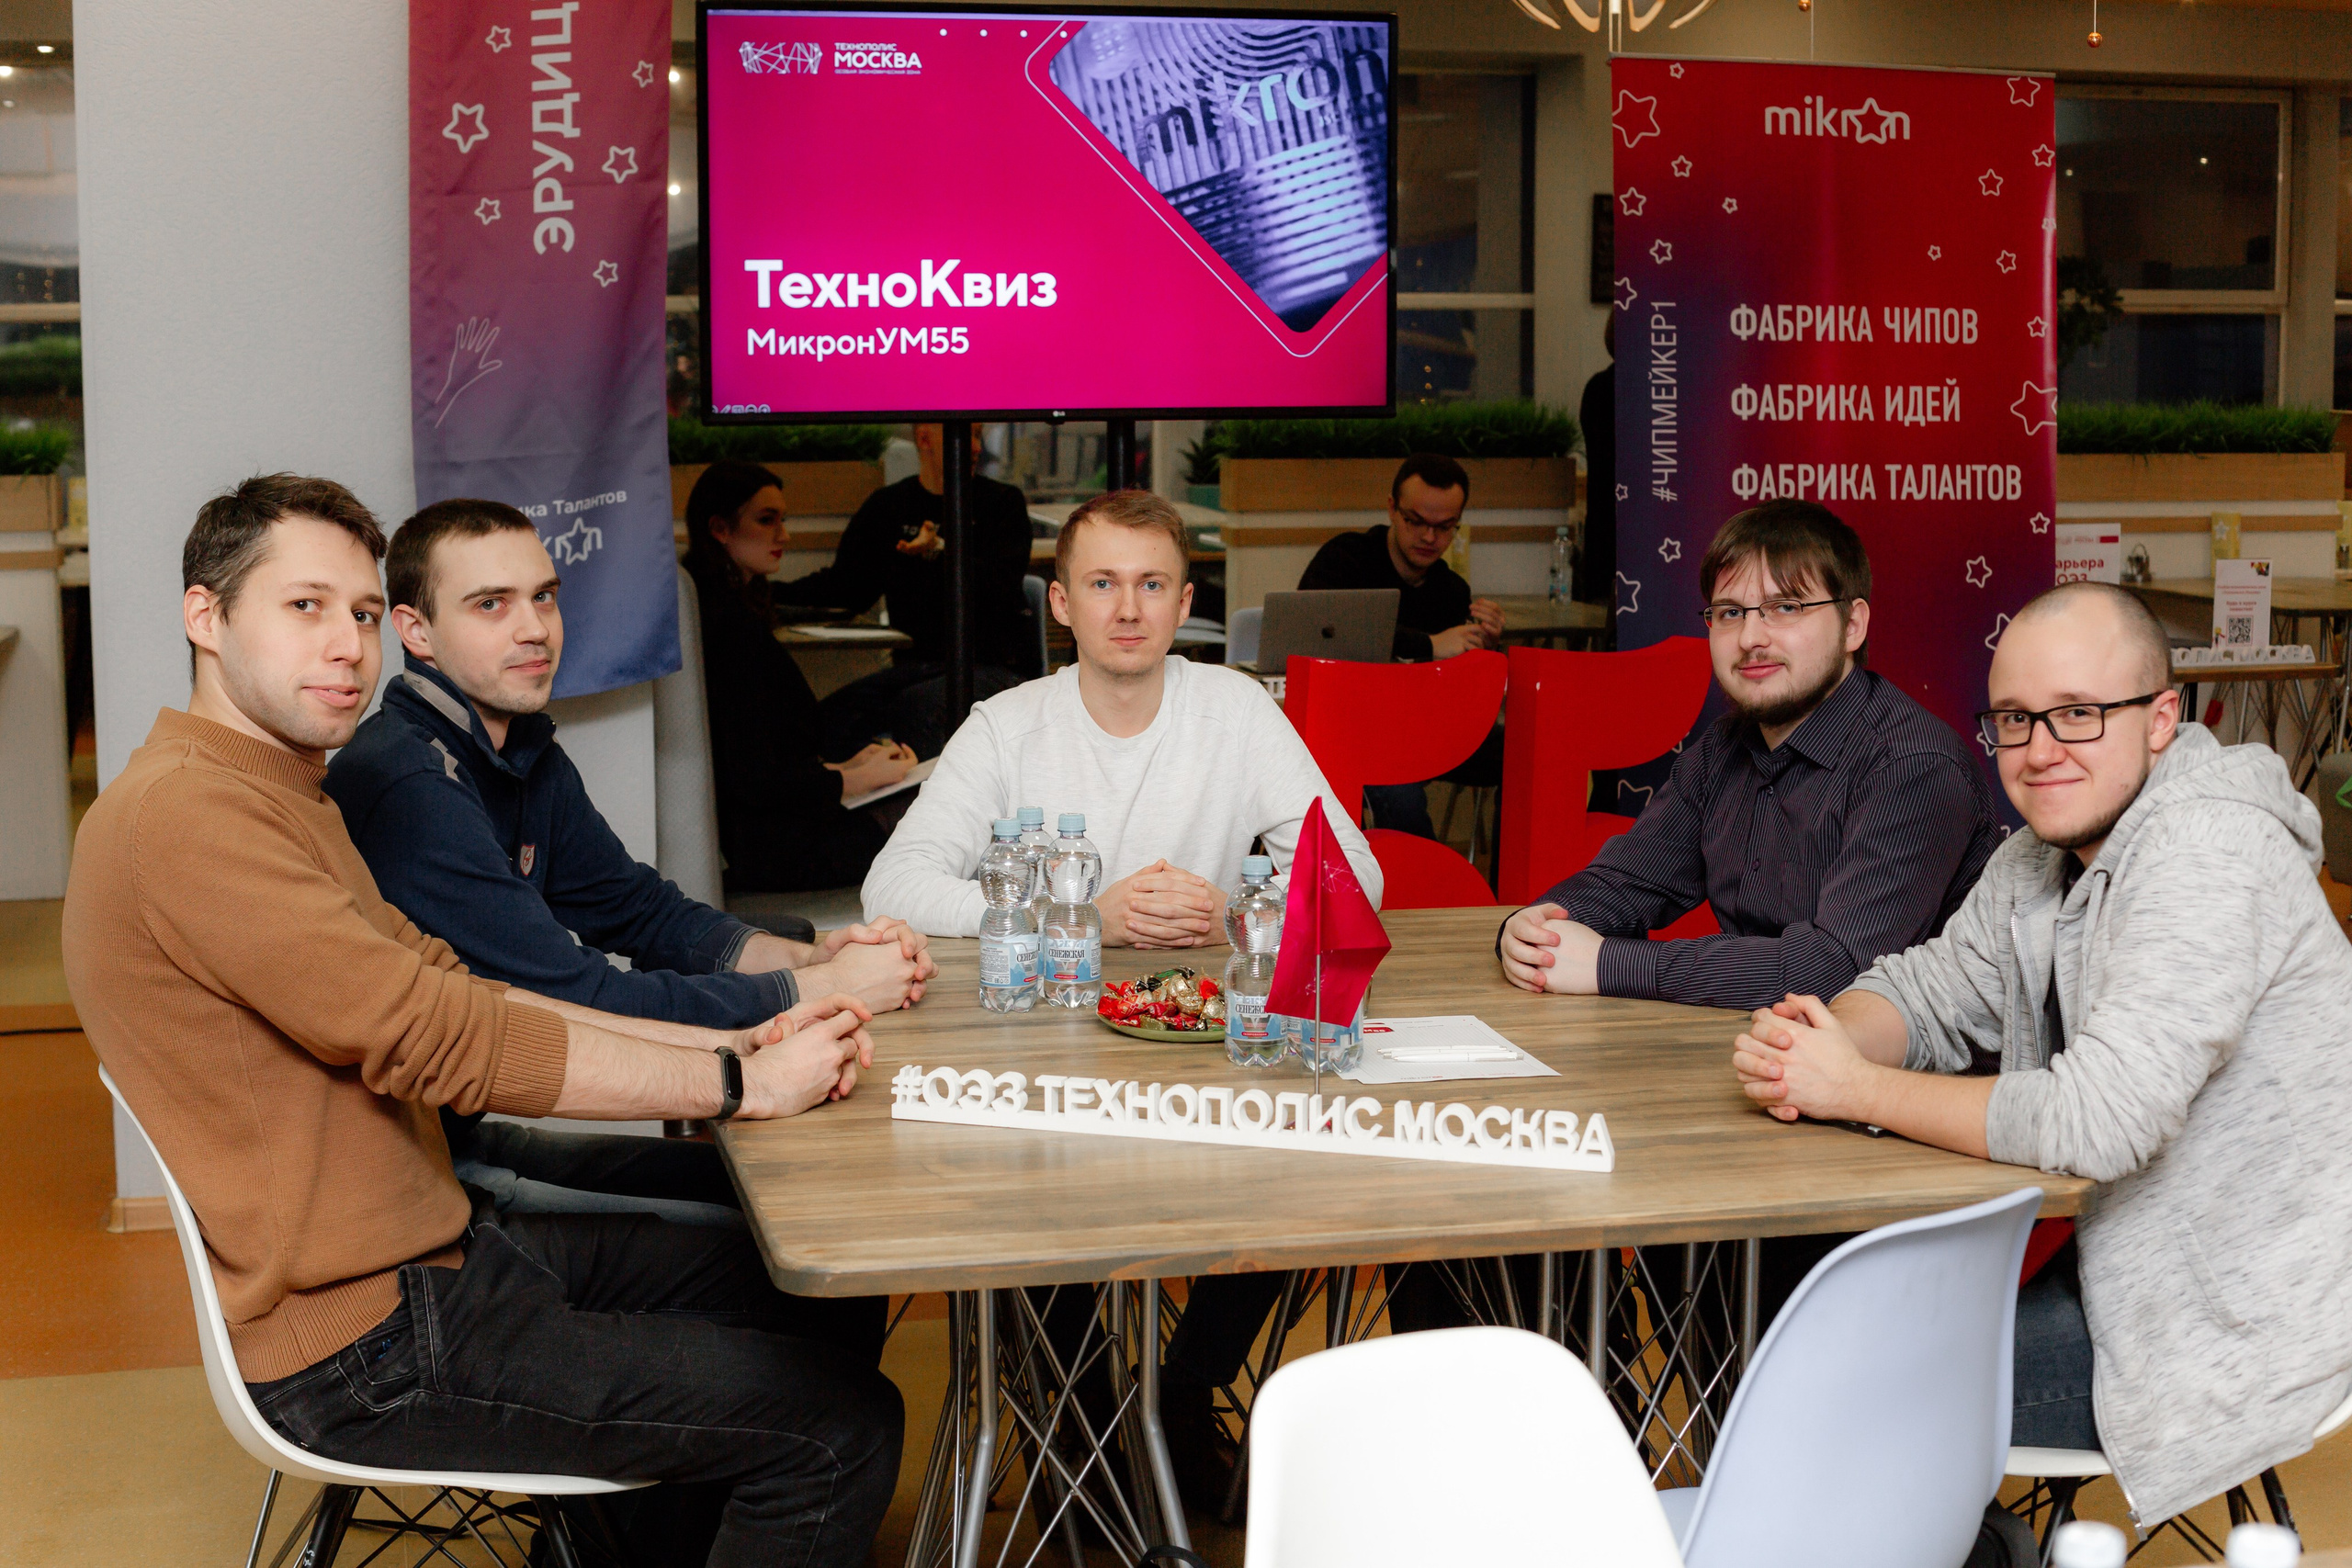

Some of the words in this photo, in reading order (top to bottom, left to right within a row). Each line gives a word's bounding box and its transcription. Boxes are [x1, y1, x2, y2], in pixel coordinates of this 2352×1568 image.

[834, 43, 898, 51] ТЕХНОПОЛИС
[834, 51, 922, 69] МОСКВА
[531, 0, 581, 255] ЭРУДИЦ
[744, 259, 1058, 309] ТехноКвиз
[1730, 303, 1873, 343] ФАБРИКА
[1884, 306, 1978, 344] ЧИПОВ
[747, 326, 969, 363] МикронУМ55
[1647, 301, 1678, 502] #ЧИПМЕЙКЕР1
[1731, 383, 1874, 422] ФАБРИКА
[1885, 378, 1961, 427] ИДЕЙ
[1732, 463, 1876, 501] ФАБРИКА
[1884, 463, 2022, 502] ТАЛАНТОВ
[553, 490, 628, 515] Талантов
[2055, 559, 2104, 572] арьера
[1048, 948, 1085, 959] СЕНЕЖСКАЯ
[1236, 1003, 1266, 1014] СЕНЕЖС
[891, 1065, 1029, 1113] #ОЭЗ
[1035, 1074, 1383, 1140] ТЕХНОПОЛИС
[1394, 1100, 1615, 1157] МОСКВА
